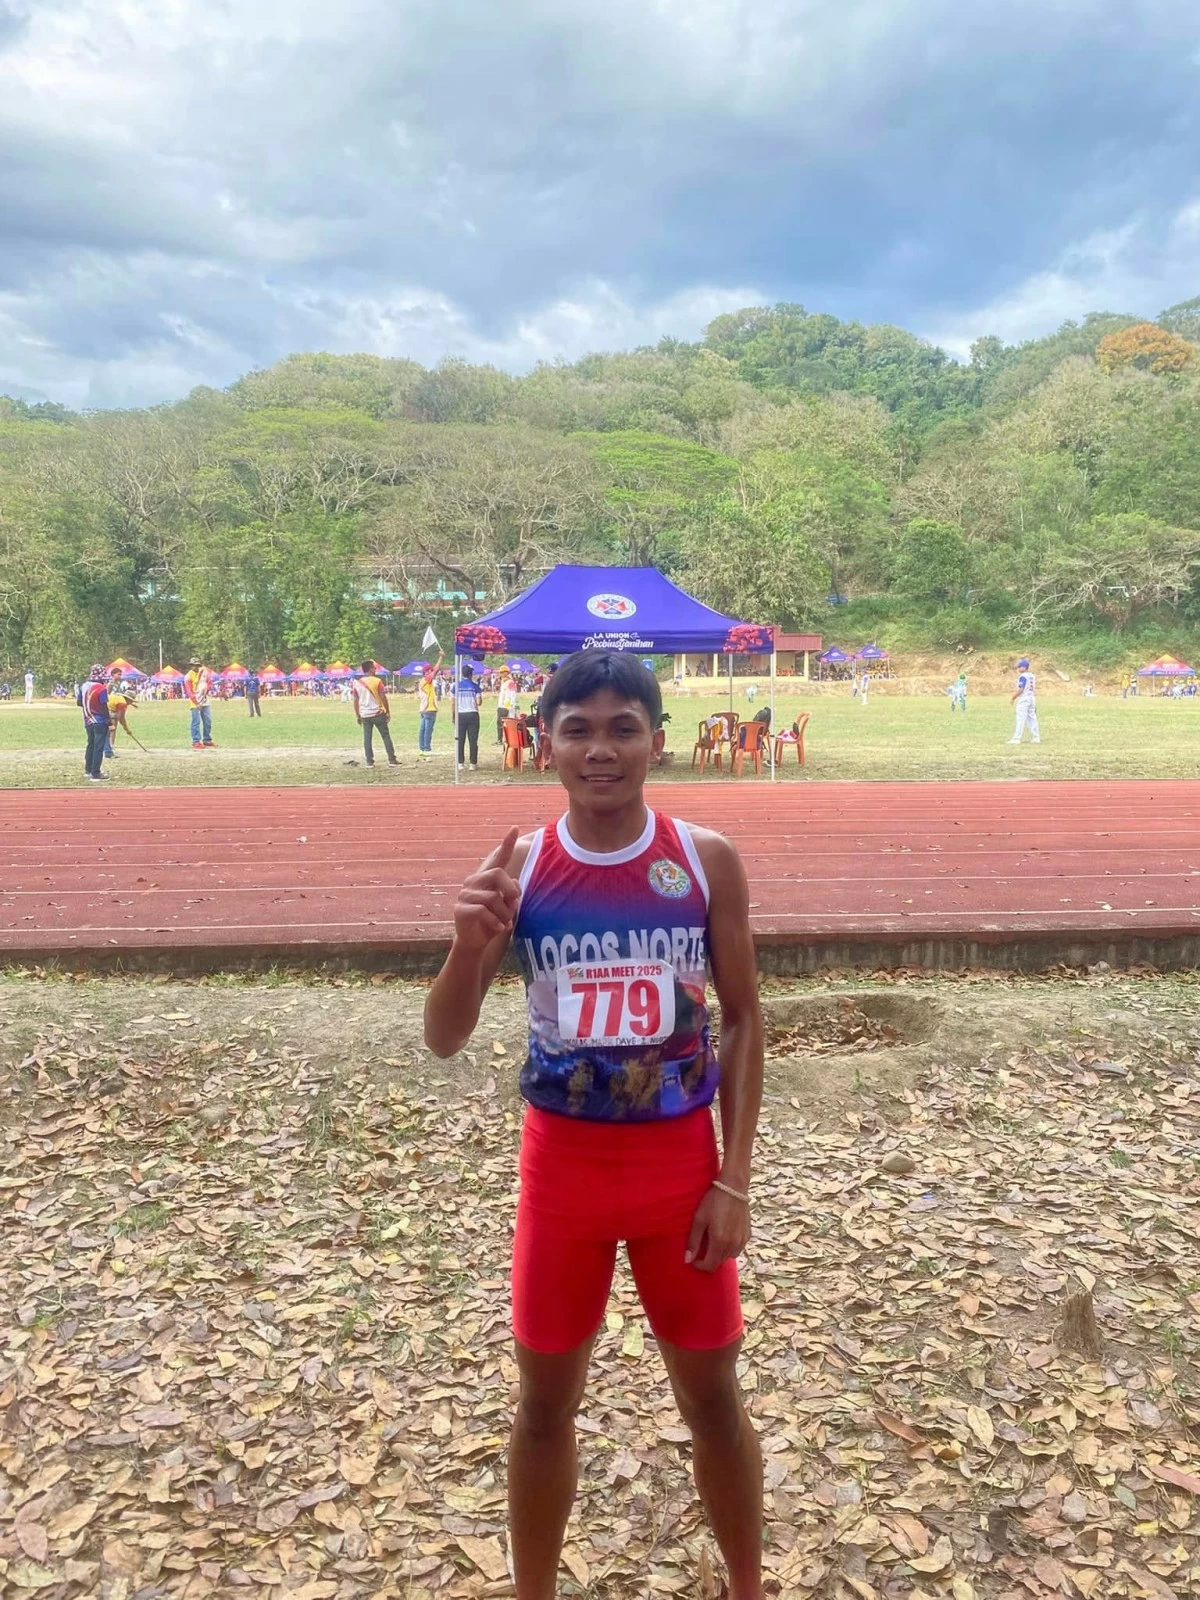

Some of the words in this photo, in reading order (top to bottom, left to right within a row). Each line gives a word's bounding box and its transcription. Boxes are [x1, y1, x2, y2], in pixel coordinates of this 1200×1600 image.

[611, 966, 635, 978] MEET
[637, 965, 662, 977] 2025
[628, 927, 706, 972] NORTE
[571, 979, 661, 1038] 779
